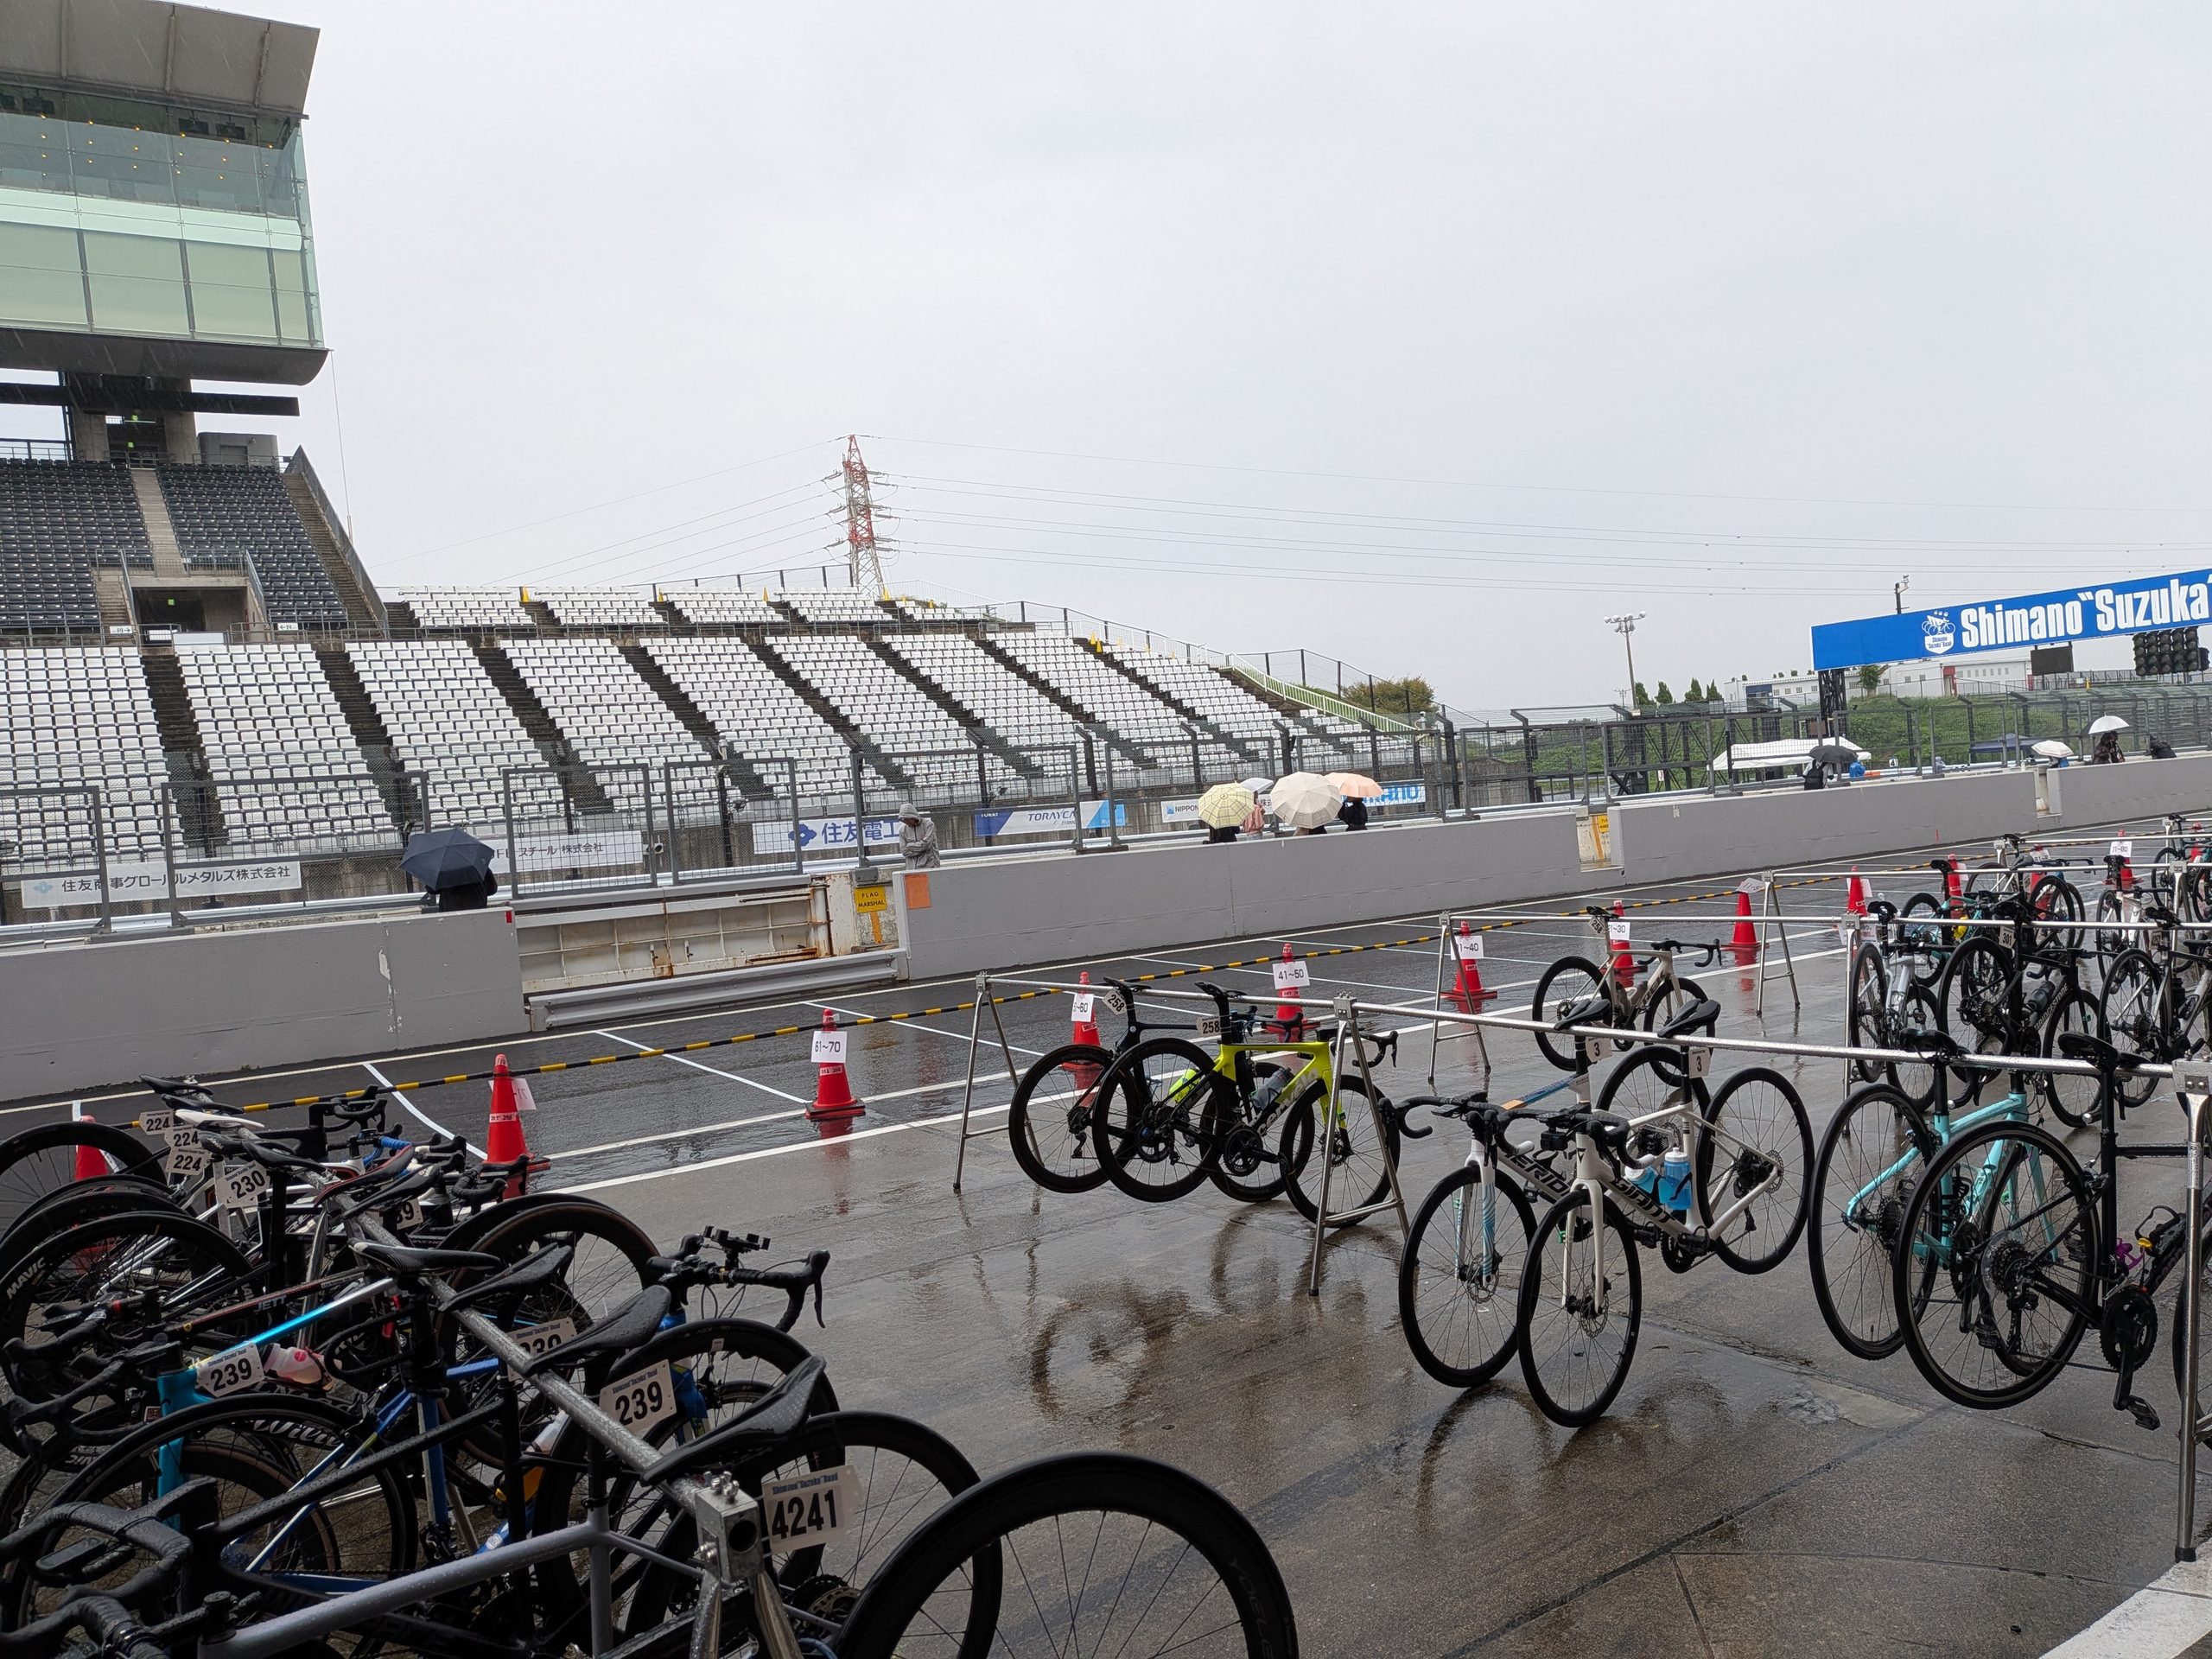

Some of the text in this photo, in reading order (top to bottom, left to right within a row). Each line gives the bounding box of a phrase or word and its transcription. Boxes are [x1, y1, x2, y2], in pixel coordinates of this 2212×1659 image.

[1961, 600, 2083, 648] Shimano
[822, 818, 900, 845] 住友電工
[857, 899, 885, 908] MARSHAL
[861, 891, 880, 899] FLAG
[1458, 943, 1478, 952] 1~40
[1107, 994, 1125, 1013] 258
[1202, 1020, 1220, 1034] 258
[815, 1041, 841, 1052] 61~70
[1593, 1042, 1600, 1057] 3
[1696, 1056, 1702, 1071] 3
[146, 1117, 170, 1132] 224
[173, 1130, 200, 1147] 224
[173, 1154, 203, 1172] 224
[1504, 1153, 1572, 1197] ERID
[231, 1170, 266, 1199] 230
[6, 1256, 46, 1300] MAVIC
[210, 1357, 252, 1391] 239
[615, 1381, 663, 1426] 239
[772, 1489, 837, 1540] 4241
